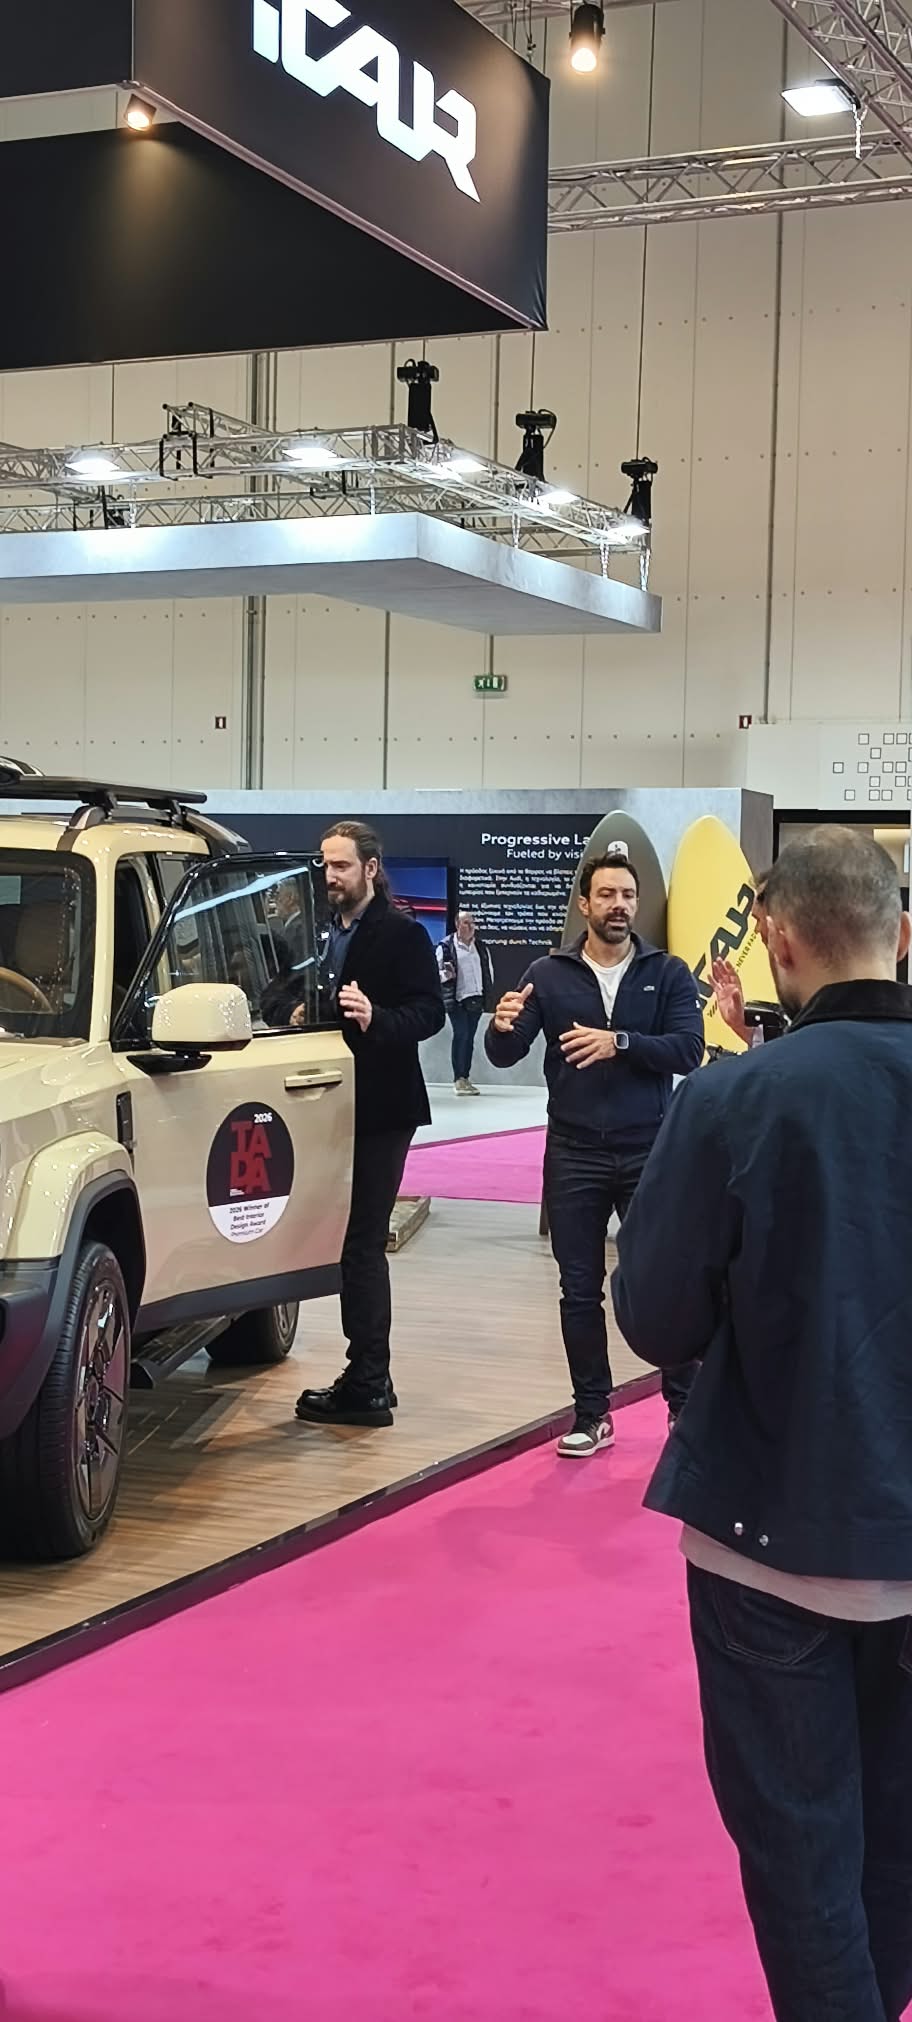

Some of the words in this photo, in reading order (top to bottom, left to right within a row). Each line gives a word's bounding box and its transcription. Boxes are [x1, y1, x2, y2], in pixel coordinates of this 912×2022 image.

[481, 833, 570, 848] Progressive
[574, 833, 590, 845] La
[506, 848, 545, 859] Fueled
[549, 849, 562, 861] by
[564, 849, 584, 859] visi
[253, 1112, 273, 1124] 2026
